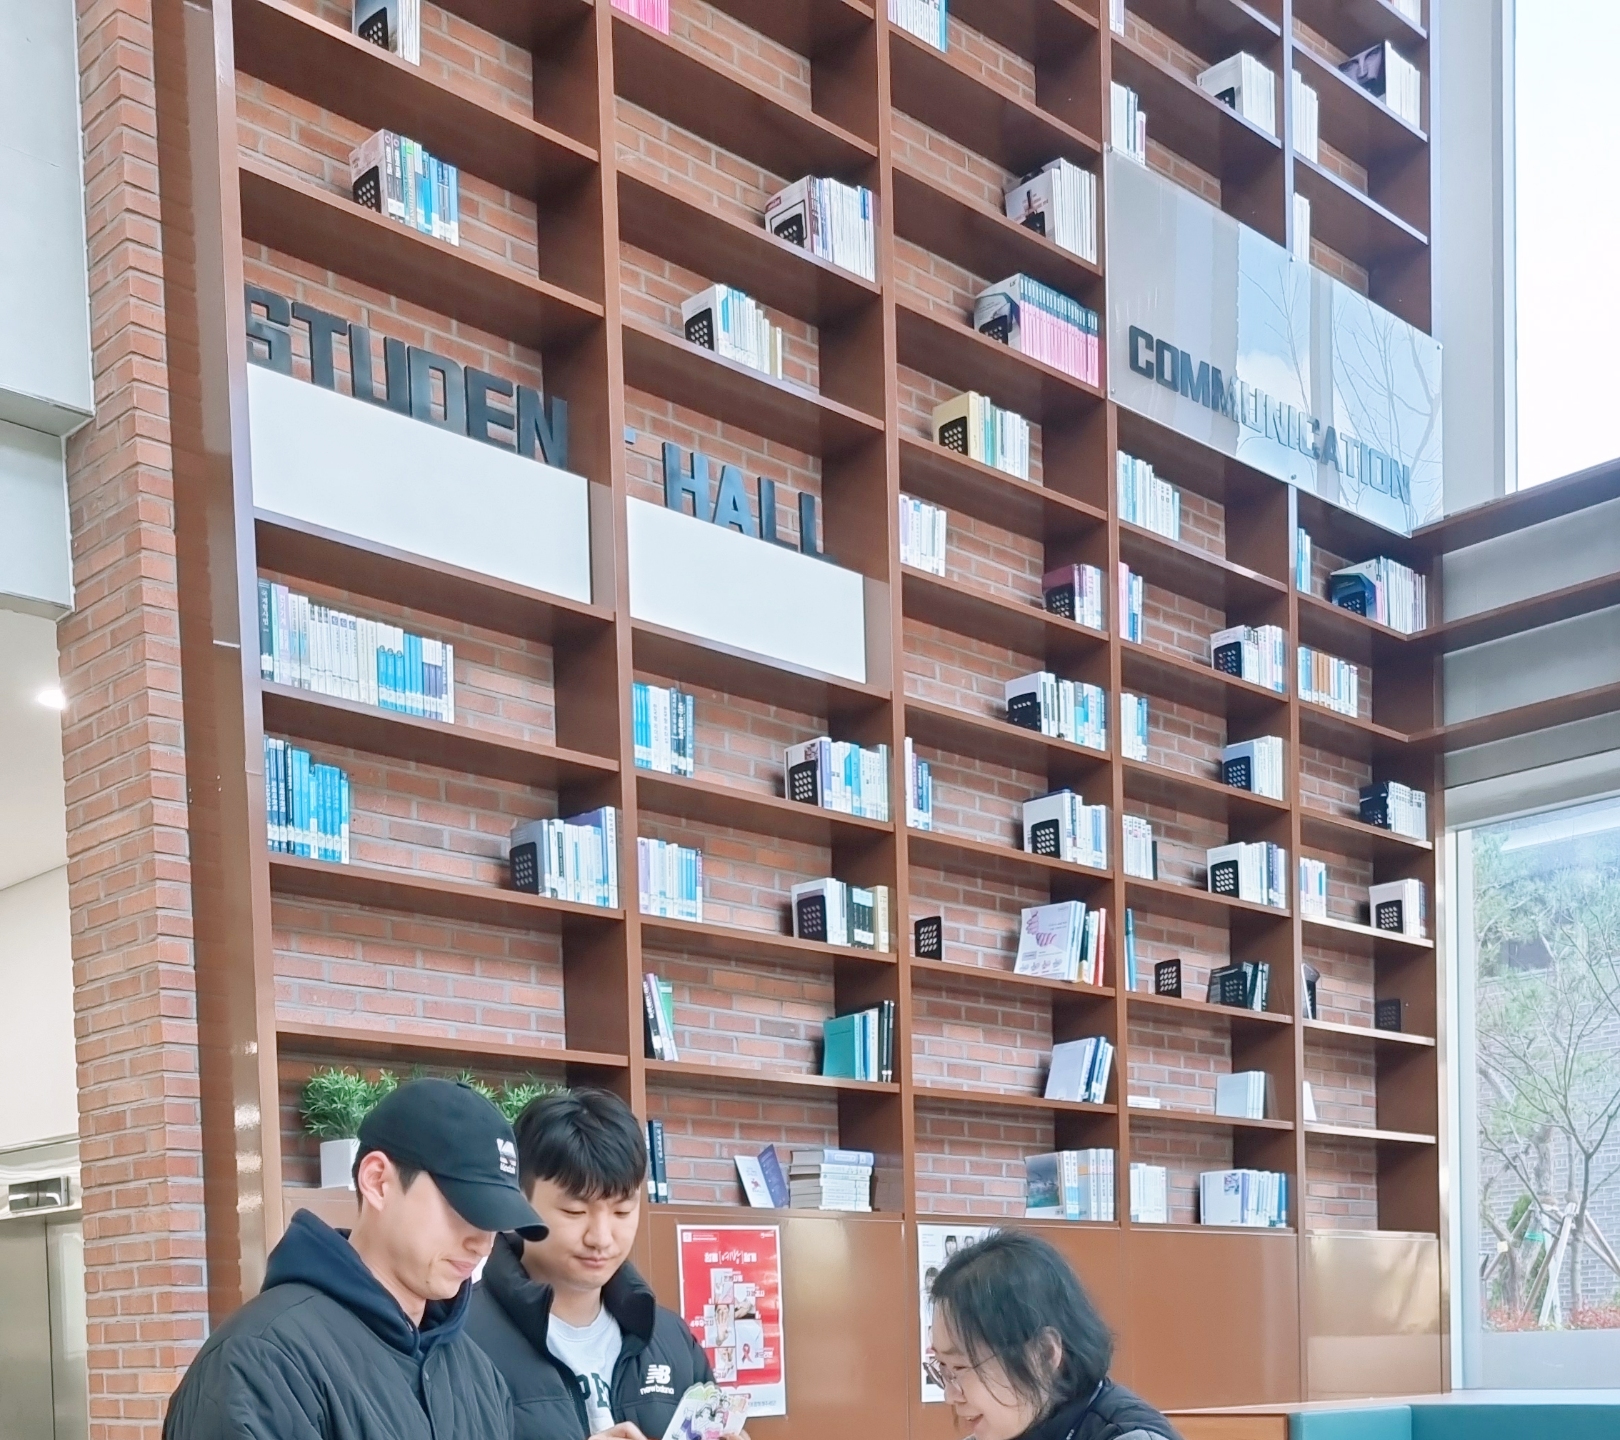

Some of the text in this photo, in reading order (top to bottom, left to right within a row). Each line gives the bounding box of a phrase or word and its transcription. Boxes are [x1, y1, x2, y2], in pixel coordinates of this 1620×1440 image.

[245, 285, 837, 564] STUDEN HALL
[1129, 324, 1411, 506] COMMUNICATION
